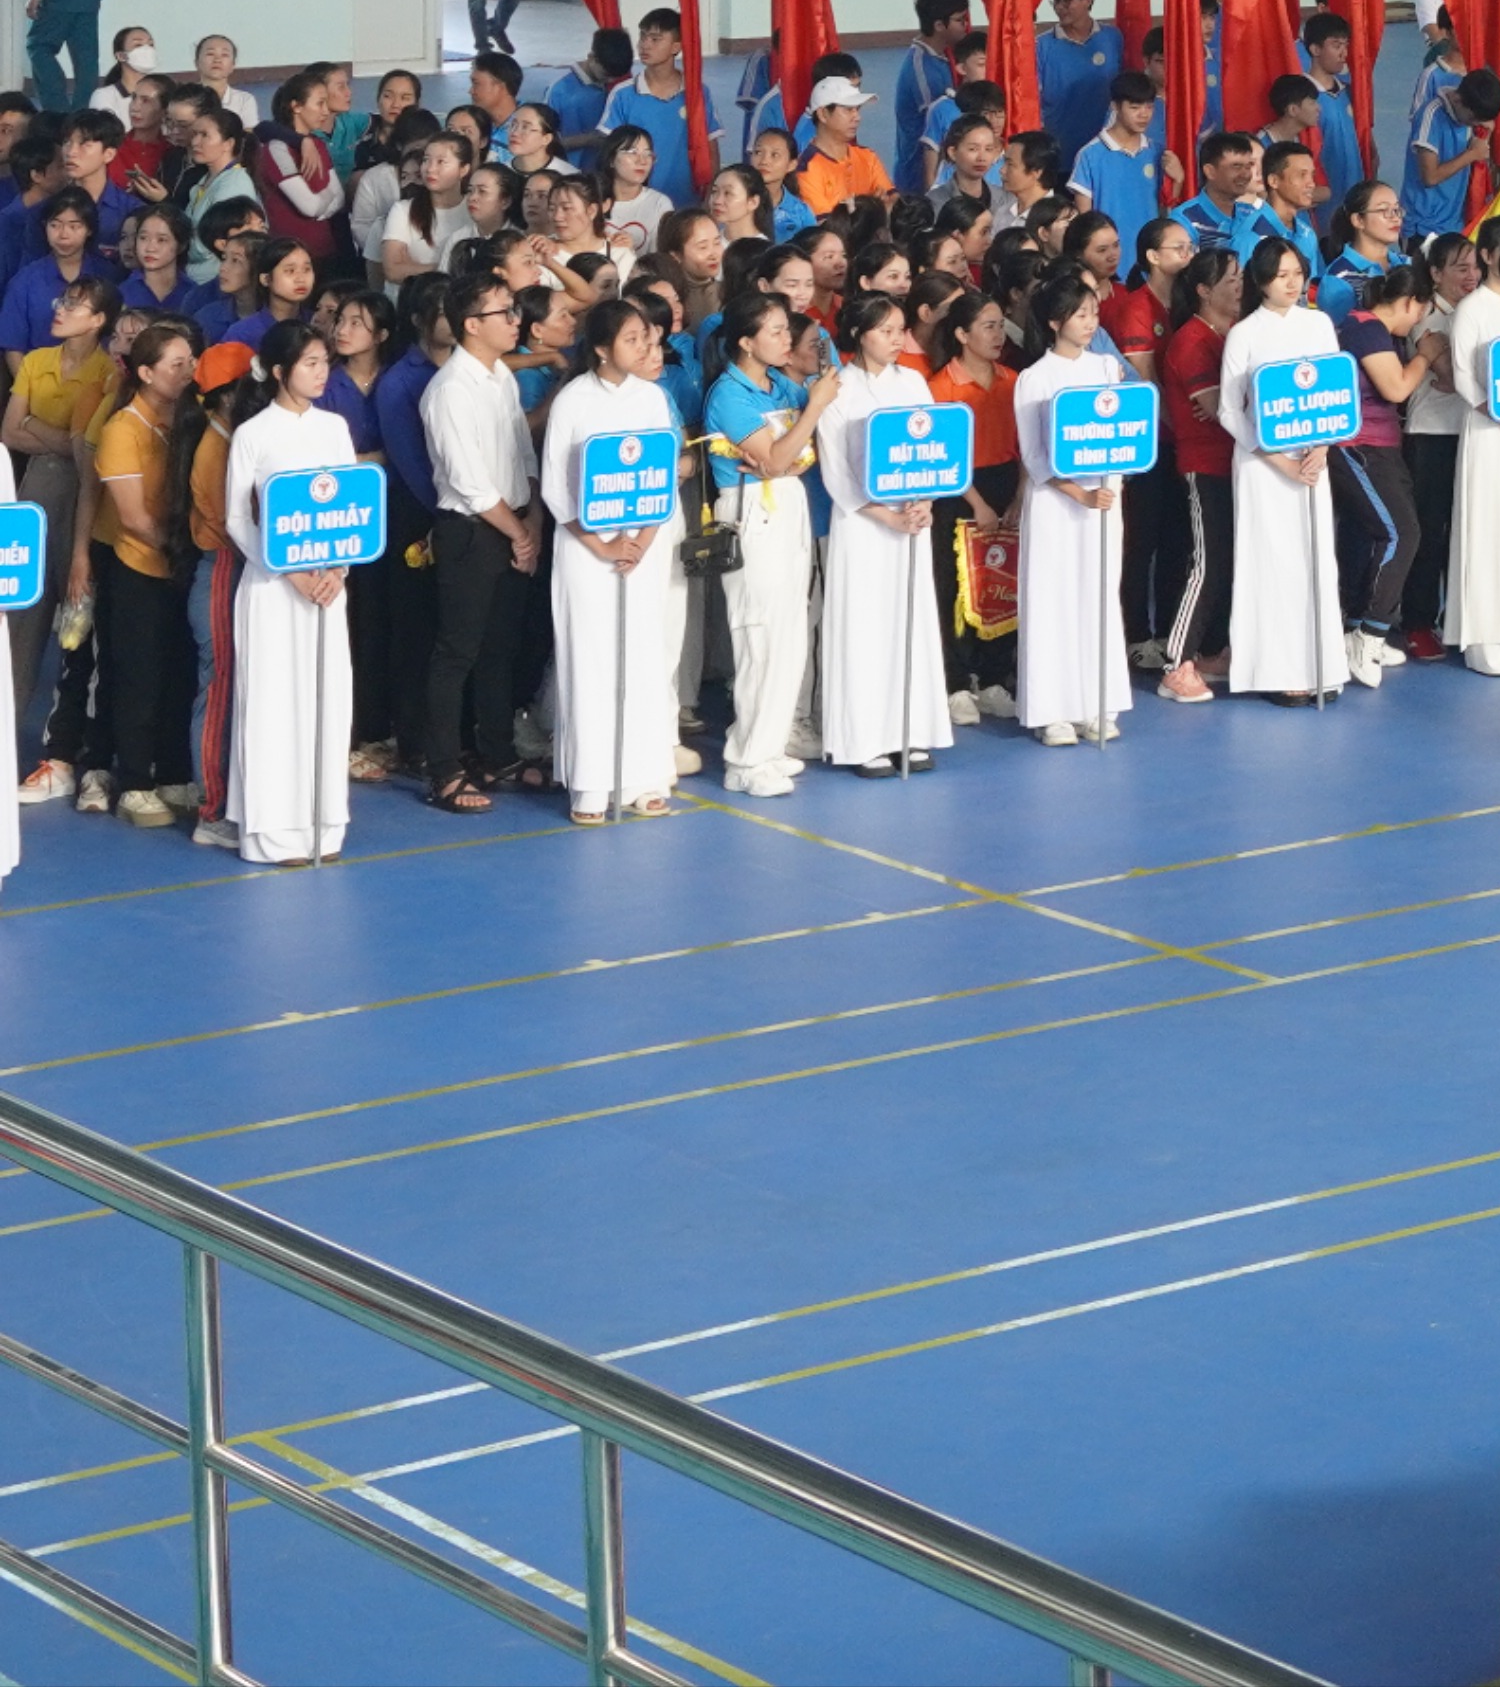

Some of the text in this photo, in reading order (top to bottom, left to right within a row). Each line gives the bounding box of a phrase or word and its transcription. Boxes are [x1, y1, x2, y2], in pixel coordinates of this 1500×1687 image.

[1263, 389, 1351, 418] LỰC LƯỢNG
[1062, 419, 1148, 441] TRƯỜNG THPT
[1274, 413, 1349, 439] GIÁO DỤC
[1073, 445, 1136, 465] BÌNH SƠN
[592, 465, 667, 495] TRUNG TÂM
[276, 502, 372, 536] ĐỘI NHẢY
[286, 534, 361, 564] DÂN VŨ
